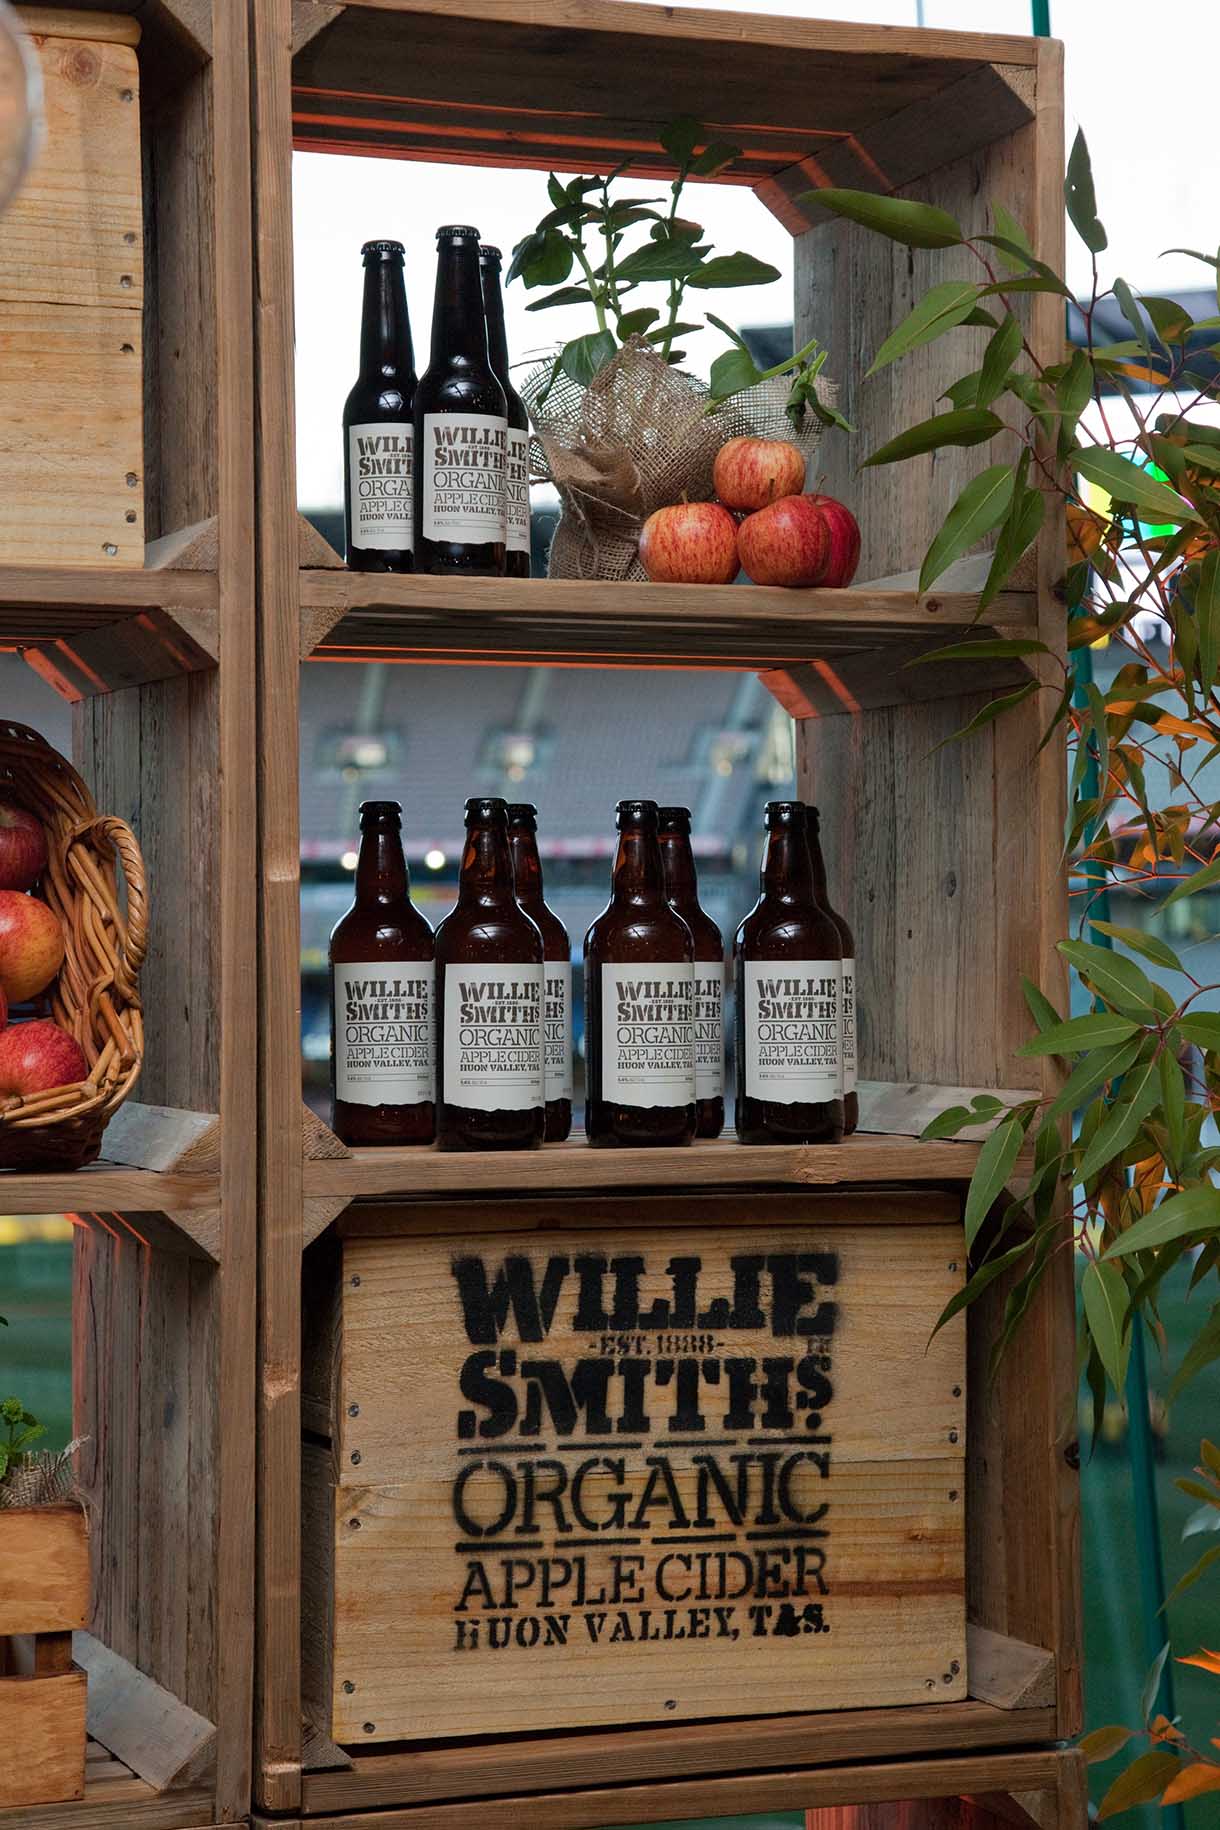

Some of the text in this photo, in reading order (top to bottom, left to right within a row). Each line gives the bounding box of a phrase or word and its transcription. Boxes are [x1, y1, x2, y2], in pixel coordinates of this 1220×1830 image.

[359, 480, 411, 497] ORGA
[360, 501, 401, 512] APPLE
[433, 492, 478, 505] APPLE
[360, 513, 384, 521] HUON
[433, 505, 460, 513] HUON
[344, 980, 428, 1000] WILLIE
[458, 982, 540, 1002] WILLIE
[615, 981, 692, 1001] WILLIE
[757, 979, 836, 998] WILLIE
[345, 1025, 428, 1043] ORGANIC
[459, 1028, 540, 1046] ORGANIC
[617, 1026, 693, 1044] ORGANIC
[758, 1023, 837, 1041] ORGANIC
[347, 1046, 429, 1059] APPLE CIDER
[460, 1050, 506, 1062] APPLE
[507, 1050, 540, 1062] CIDER
[618, 1049, 663, 1060] APPLE
[759, 1045, 804, 1057] APPLE
[804, 1045, 837, 1057] CIDER
[346, 1060, 371, 1068] HUON
[759, 1058, 785, 1066] HUON
[452, 1253, 838, 1344] WILLIE
[452, 1451, 830, 1536] ORGANIC
[454, 1546, 829, 1610] APPLE CIDER
[454, 1614, 571, 1651] HUON
[584, 1607, 740, 1642] VALLEY,
